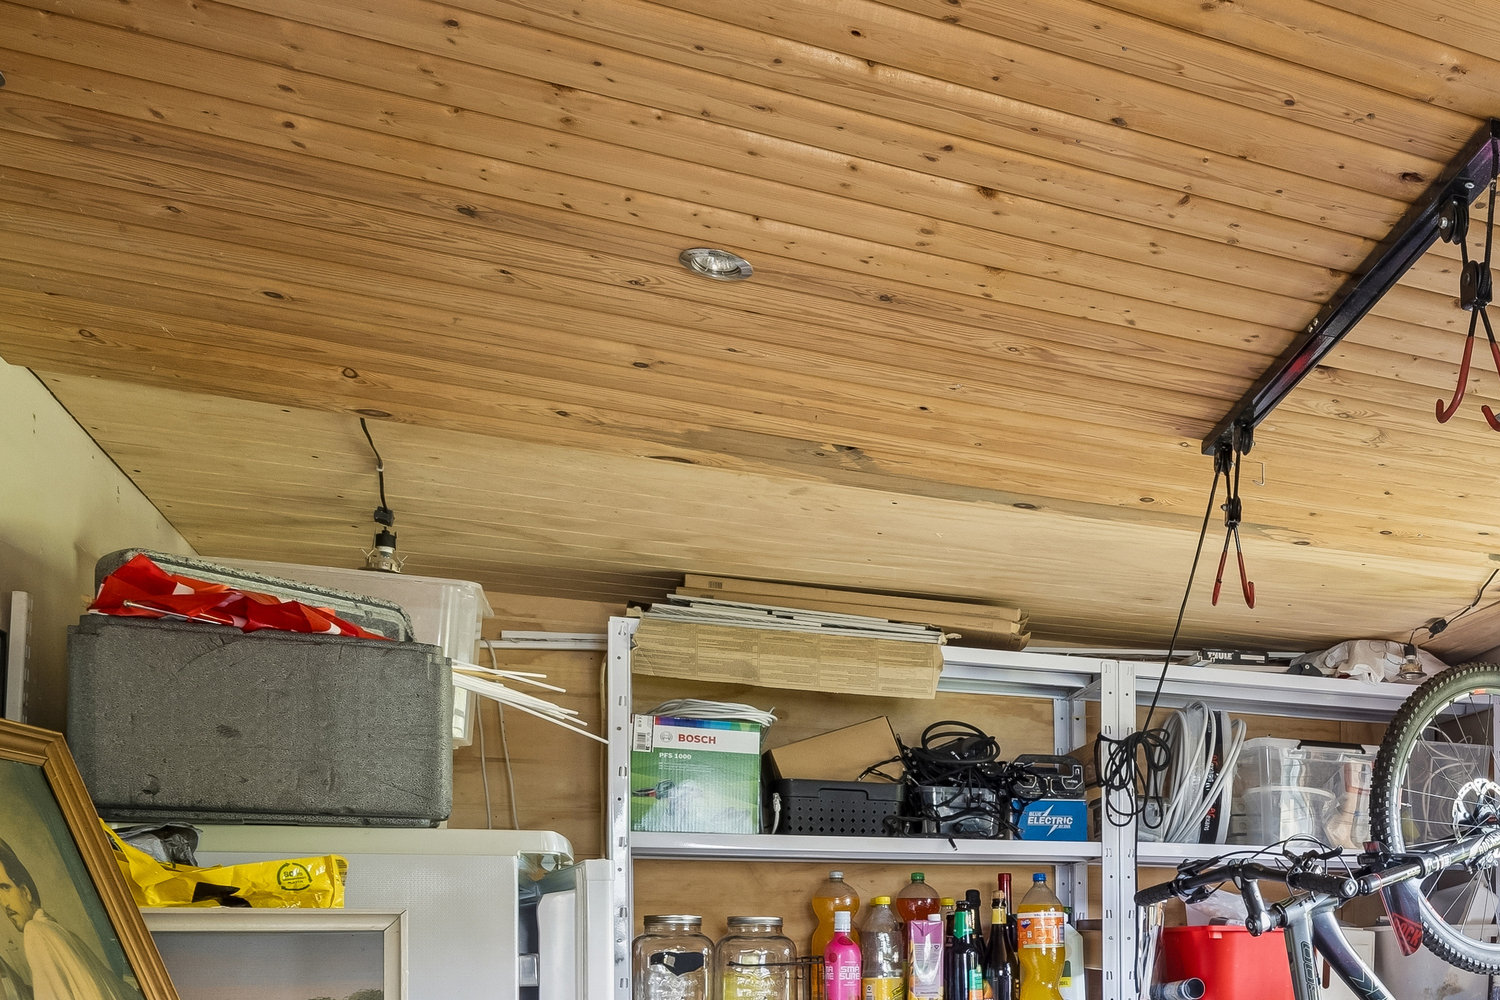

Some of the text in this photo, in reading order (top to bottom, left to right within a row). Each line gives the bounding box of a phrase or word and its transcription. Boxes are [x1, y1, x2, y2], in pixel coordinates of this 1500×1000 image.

[1207, 651, 1234, 660] THULE
[678, 734, 716, 744] BOSCH
[1028, 816, 1073, 825] ELECTRIC
